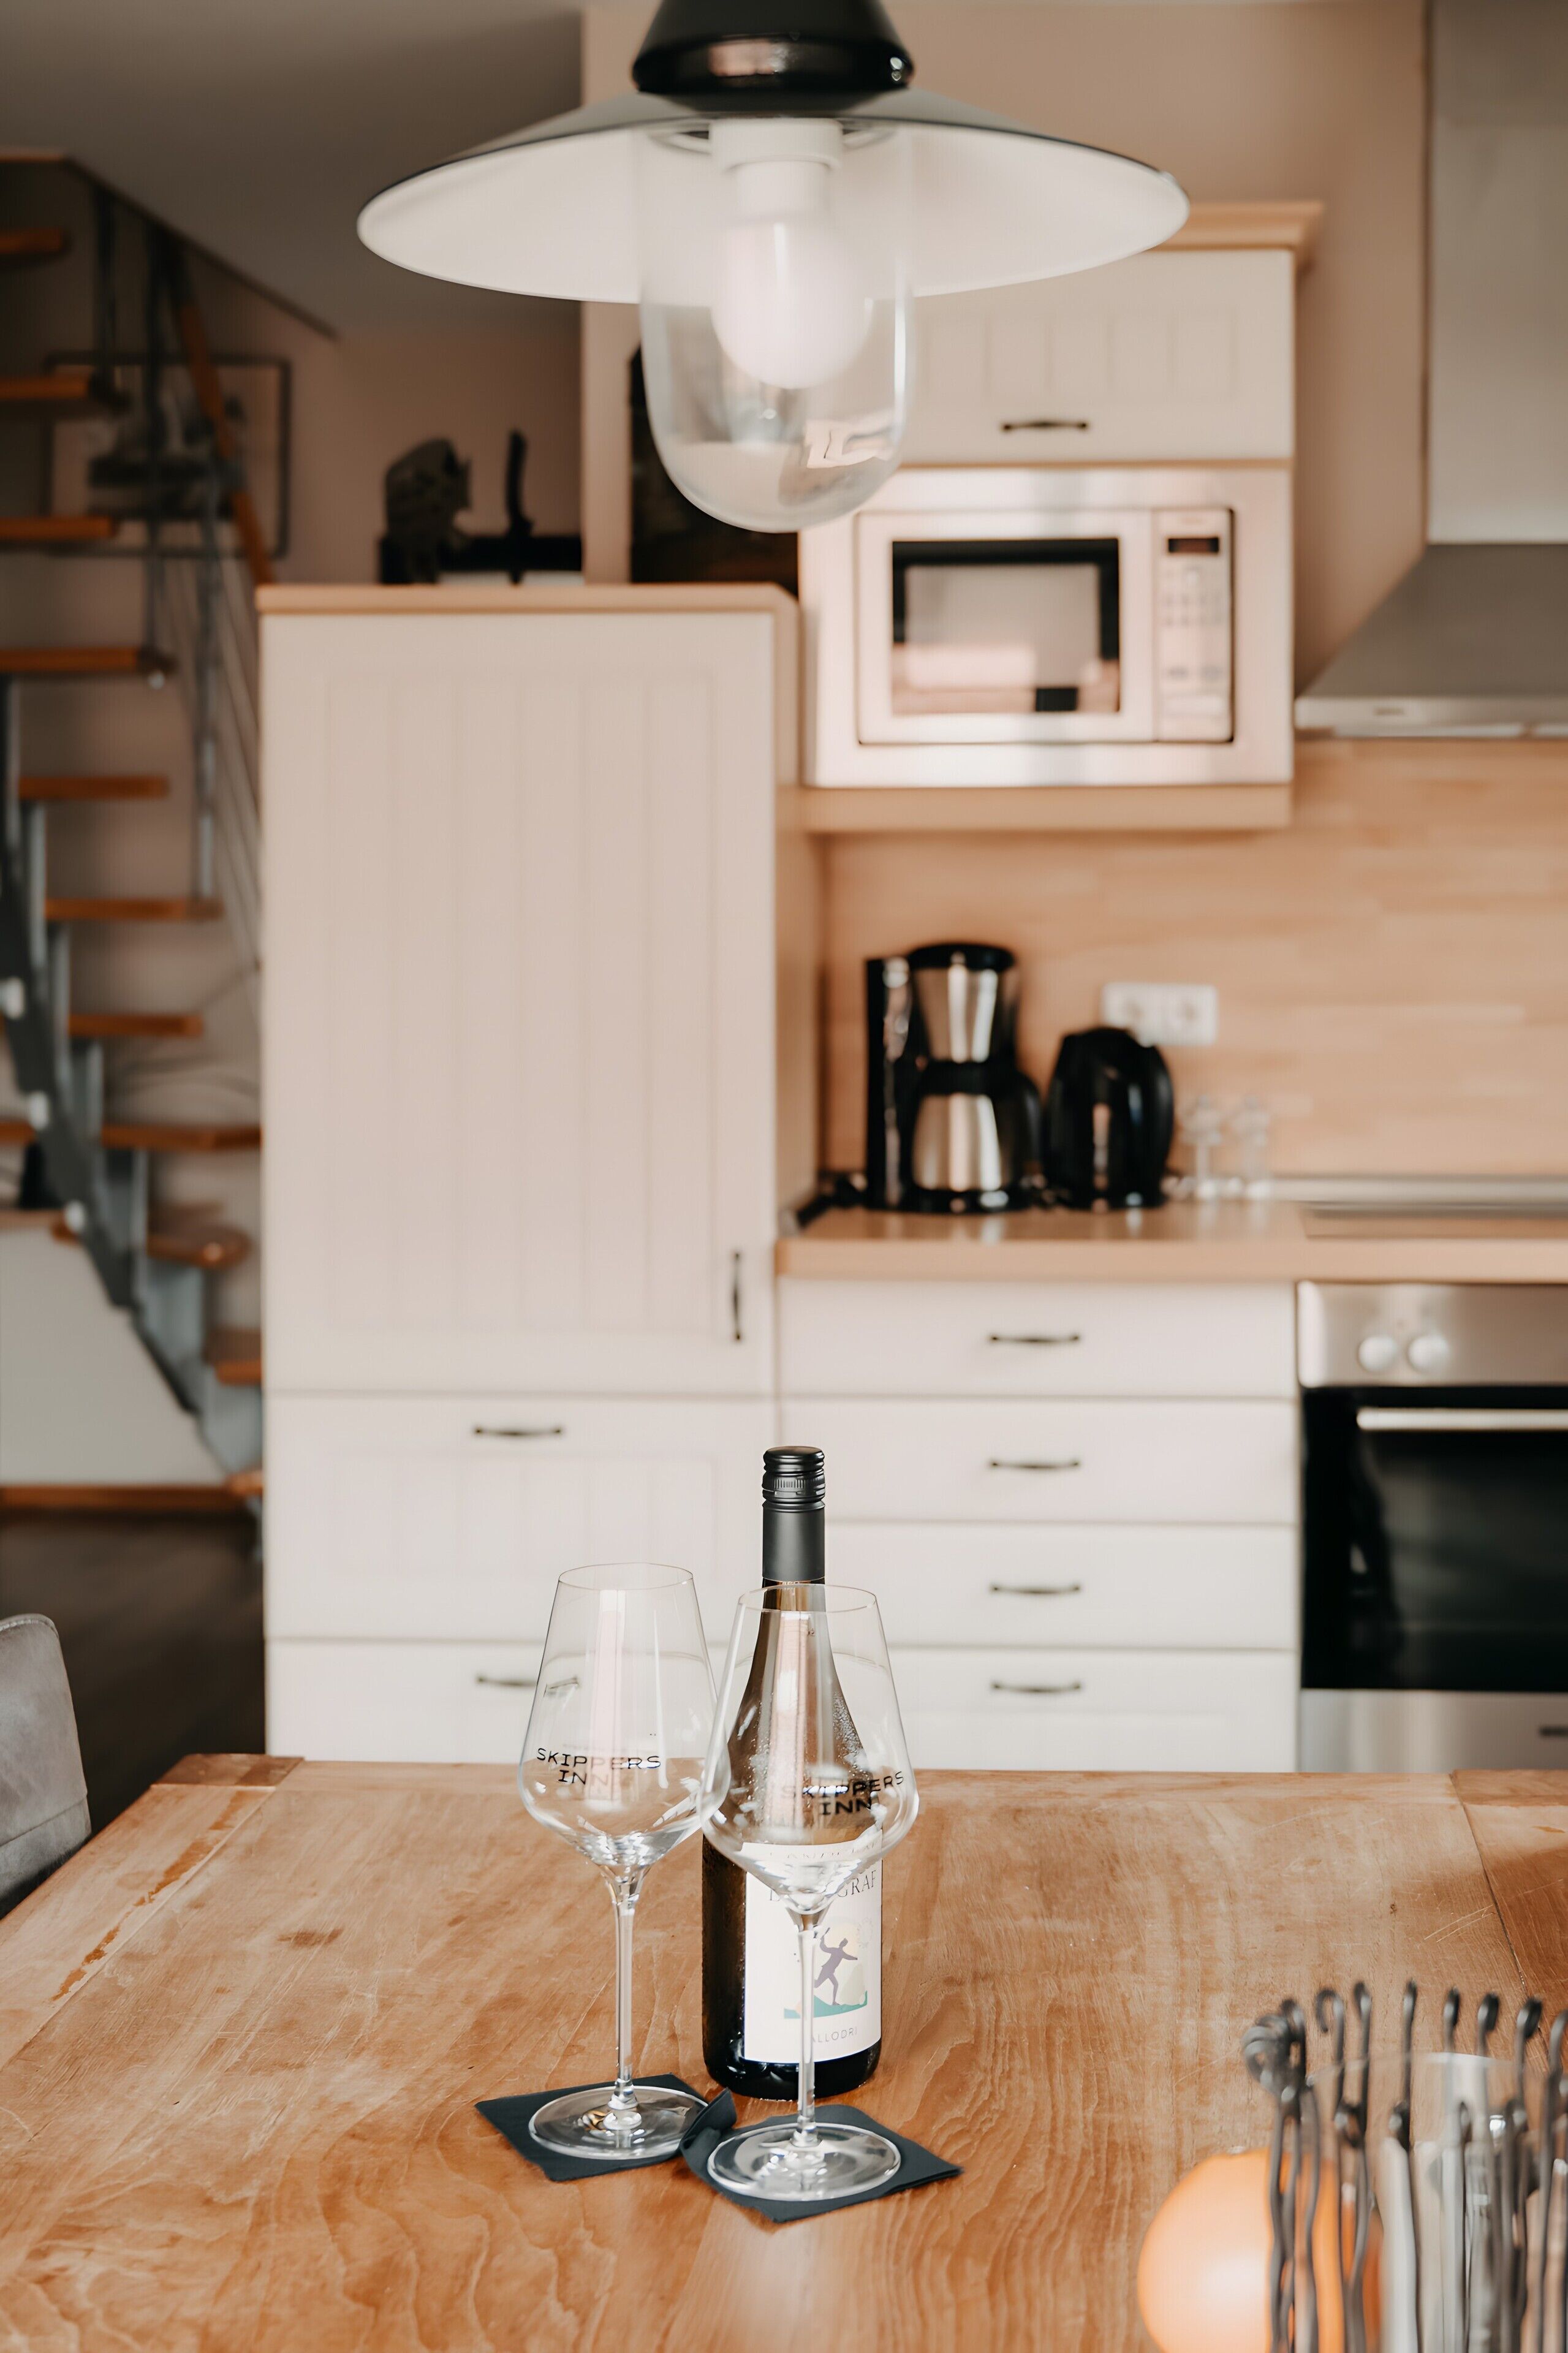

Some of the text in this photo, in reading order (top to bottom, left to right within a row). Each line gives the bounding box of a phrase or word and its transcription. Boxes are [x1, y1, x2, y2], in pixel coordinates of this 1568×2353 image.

[536, 1748, 662, 1770] SKIPPERS
[558, 1769, 609, 1786] INN
[821, 1796, 871, 1816] INN
